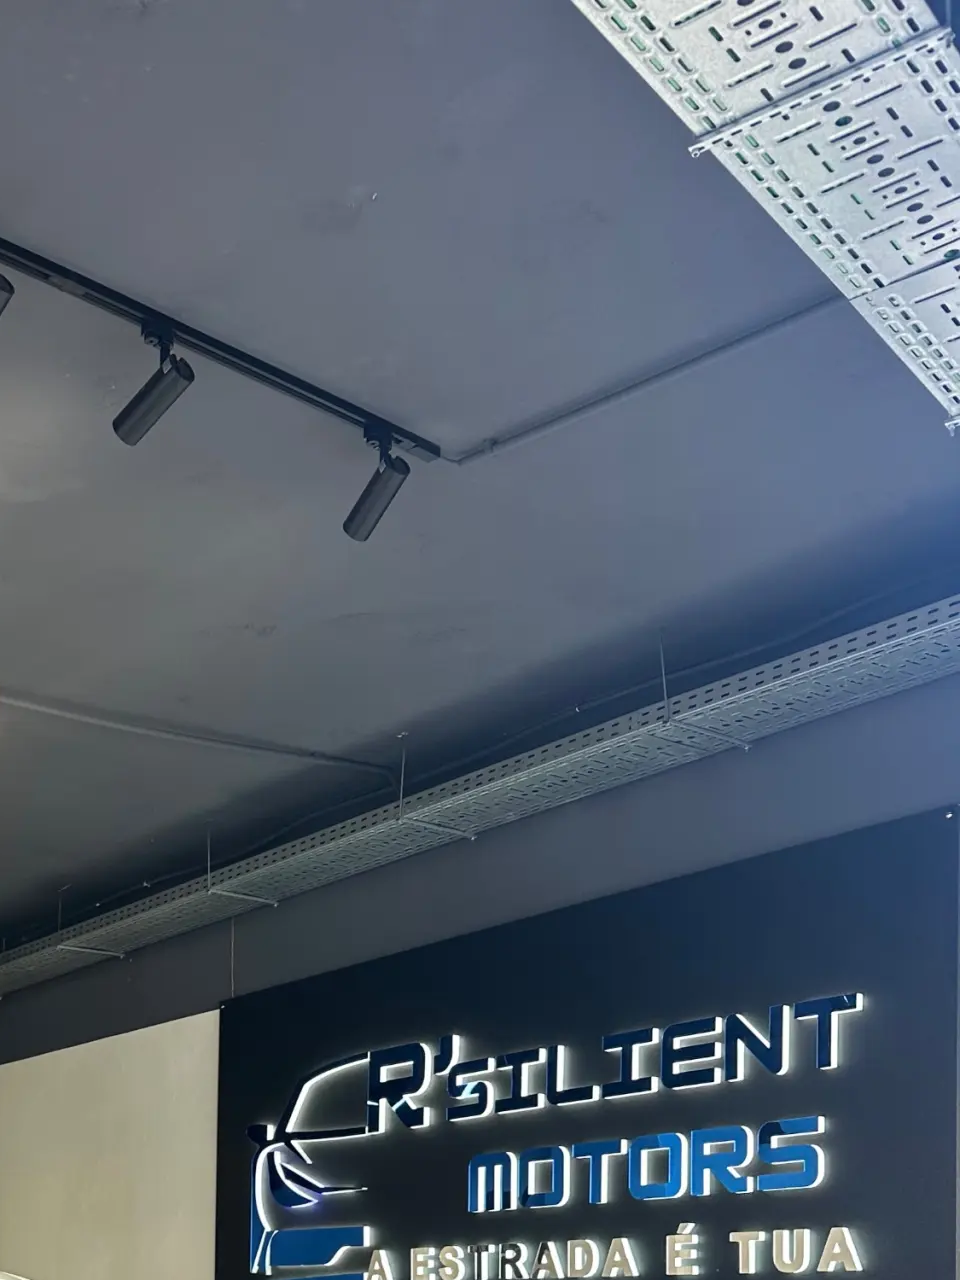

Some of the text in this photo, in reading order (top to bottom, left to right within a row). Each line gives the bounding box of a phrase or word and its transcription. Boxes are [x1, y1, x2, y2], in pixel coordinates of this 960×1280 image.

[366, 992, 865, 1136] R'SILIENT
[467, 1115, 825, 1213] MOTORS
[665, 1222, 700, 1277] É
[729, 1226, 865, 1276] TUA
